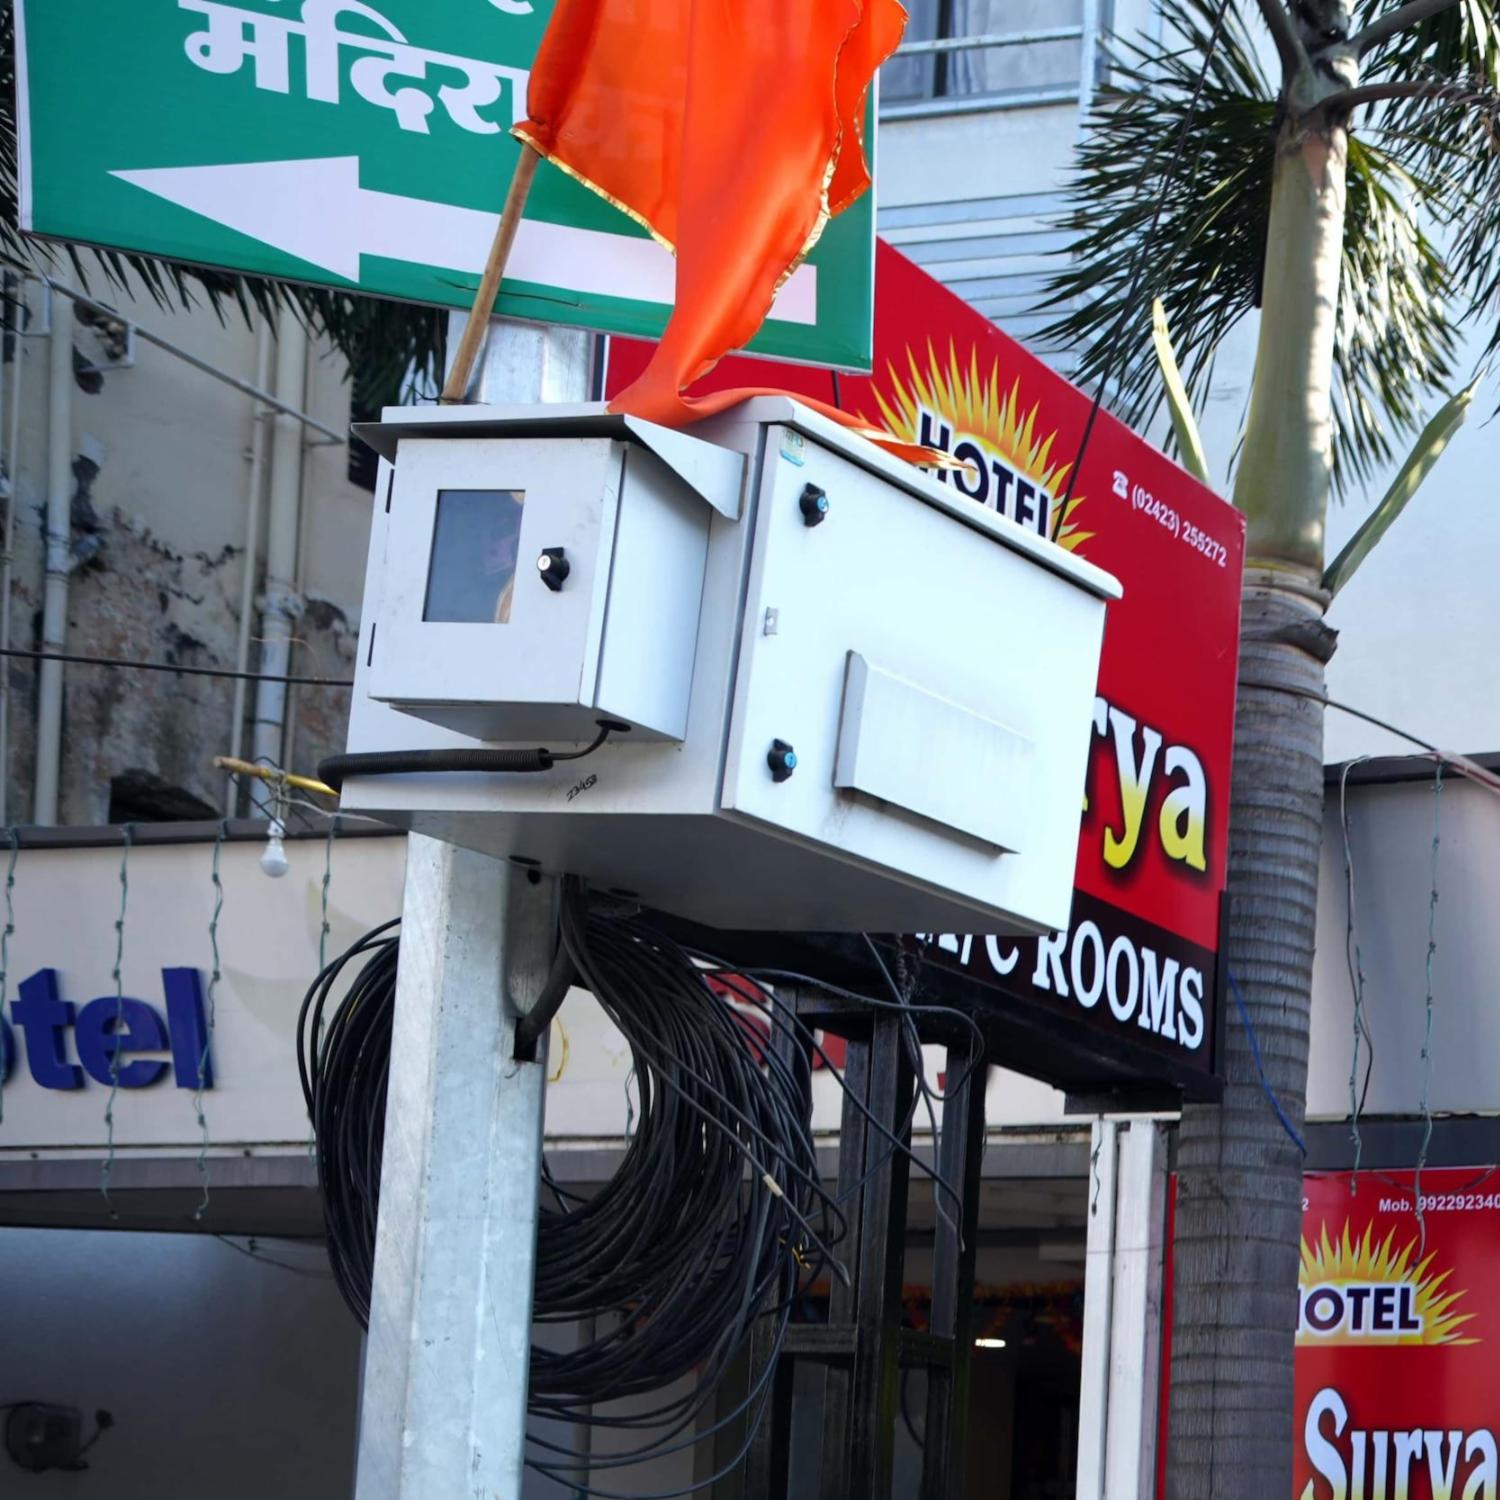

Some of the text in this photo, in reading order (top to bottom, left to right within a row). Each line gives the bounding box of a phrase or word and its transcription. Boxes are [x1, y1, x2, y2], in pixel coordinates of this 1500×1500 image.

[1132, 484, 1227, 568] (02423) 255272
[1032, 919, 1204, 1050] ROOMS
[1379, 1199, 1413, 1213] Mob.
[1297, 1287, 1420, 1332] OTEL
